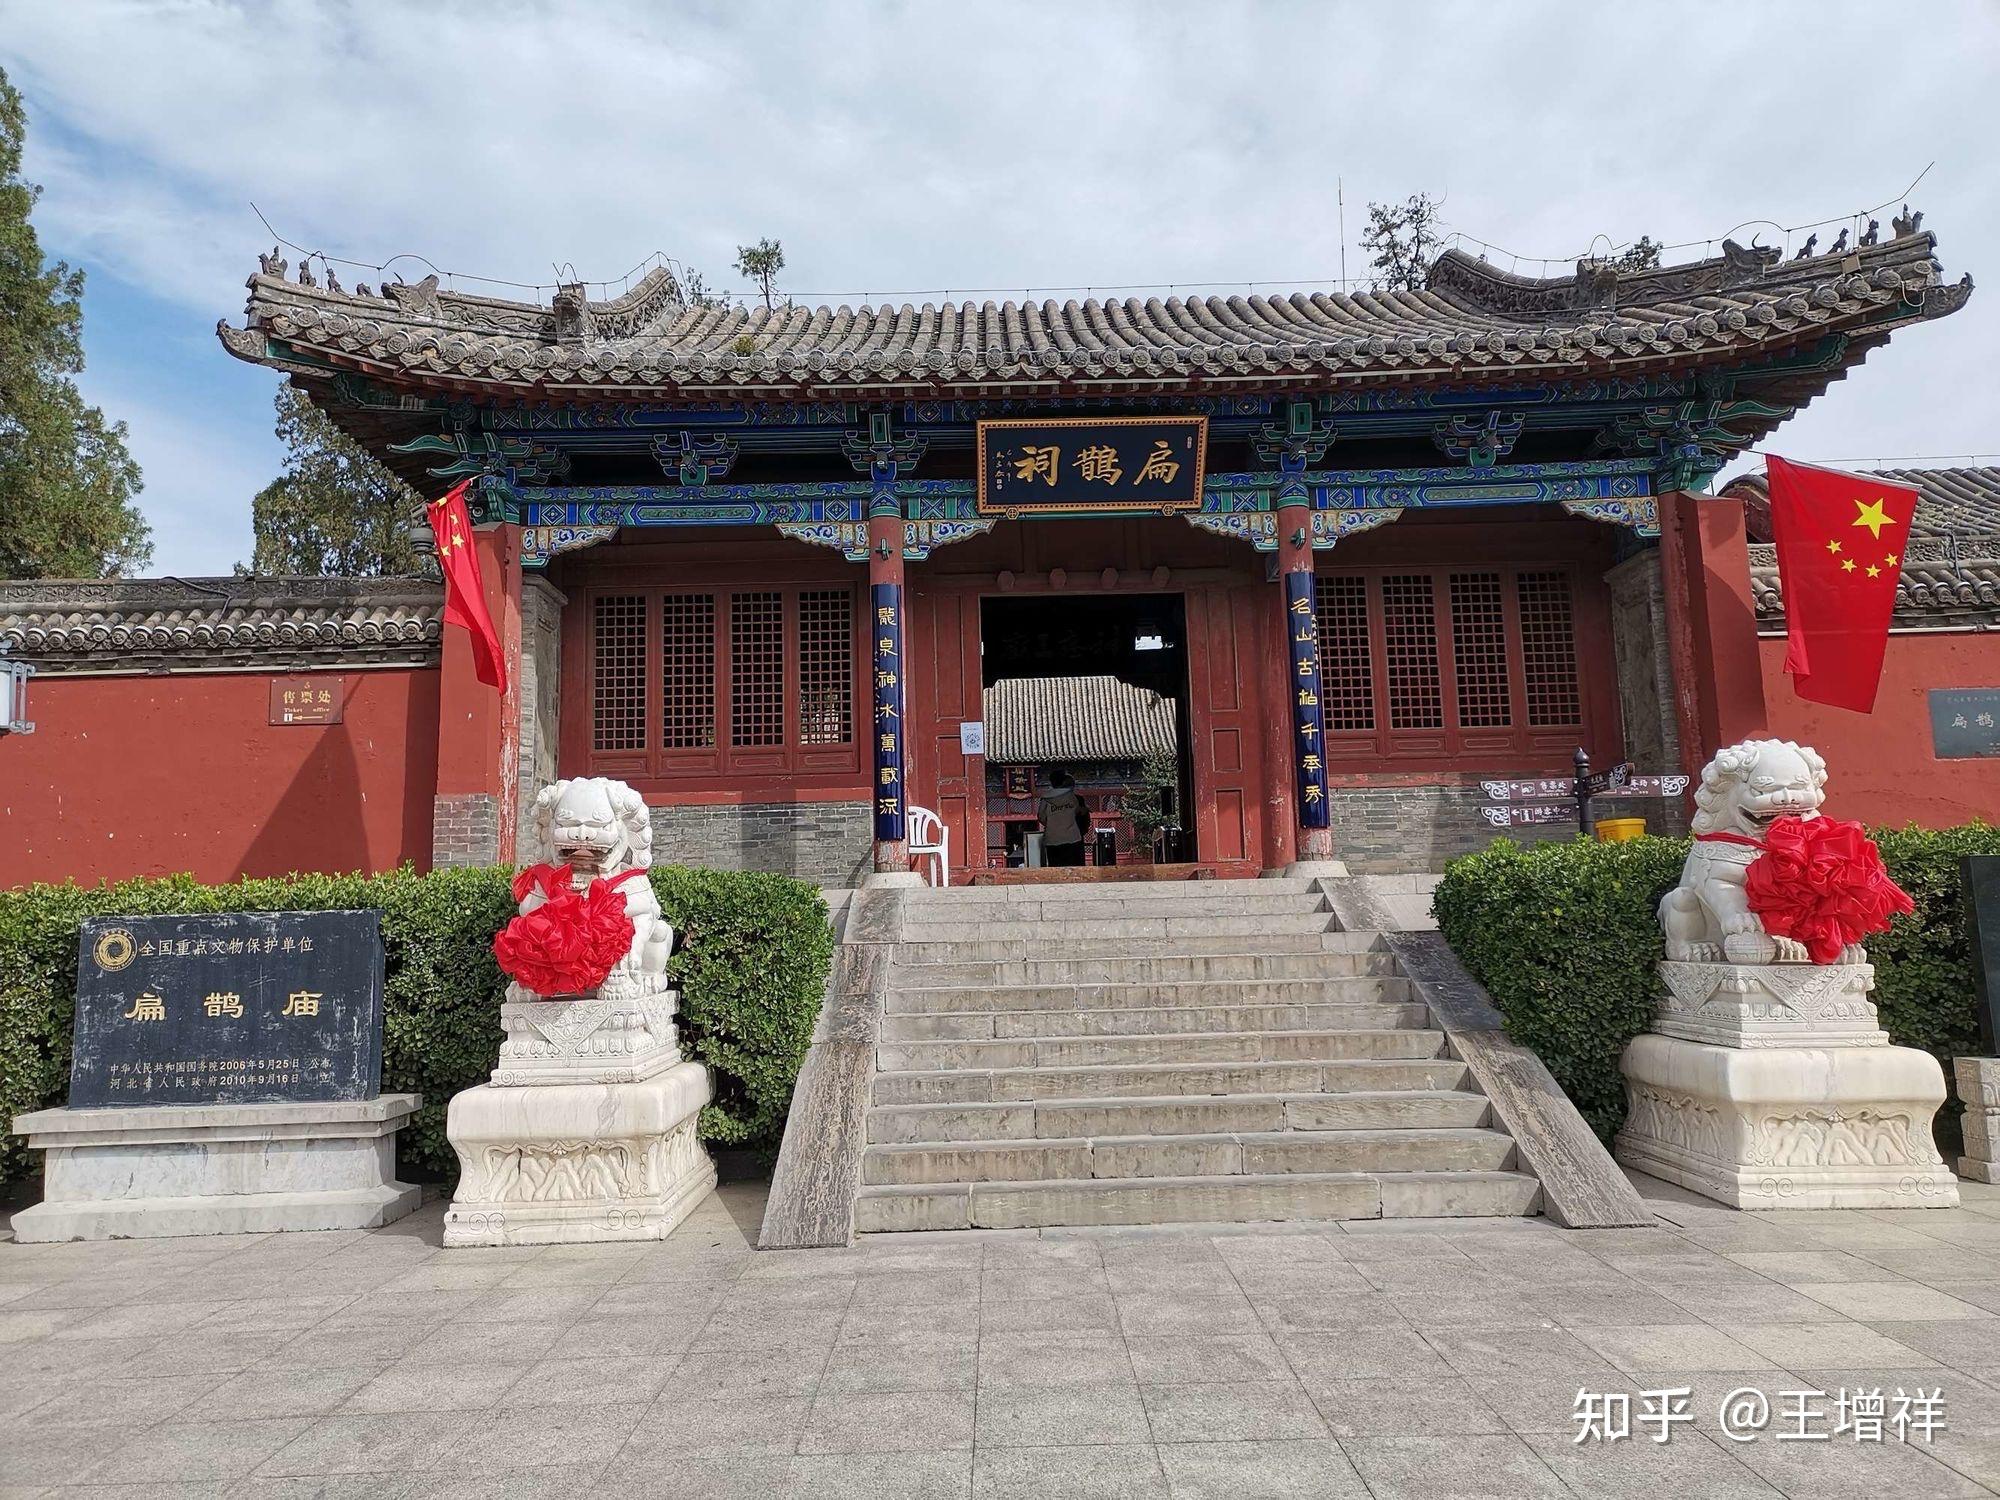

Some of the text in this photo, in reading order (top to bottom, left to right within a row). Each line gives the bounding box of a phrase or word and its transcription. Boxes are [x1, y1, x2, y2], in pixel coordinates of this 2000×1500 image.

[139, 936, 314, 957] 全国重点文物保护单位
[124, 990, 323, 1022] 扁鹊庙
